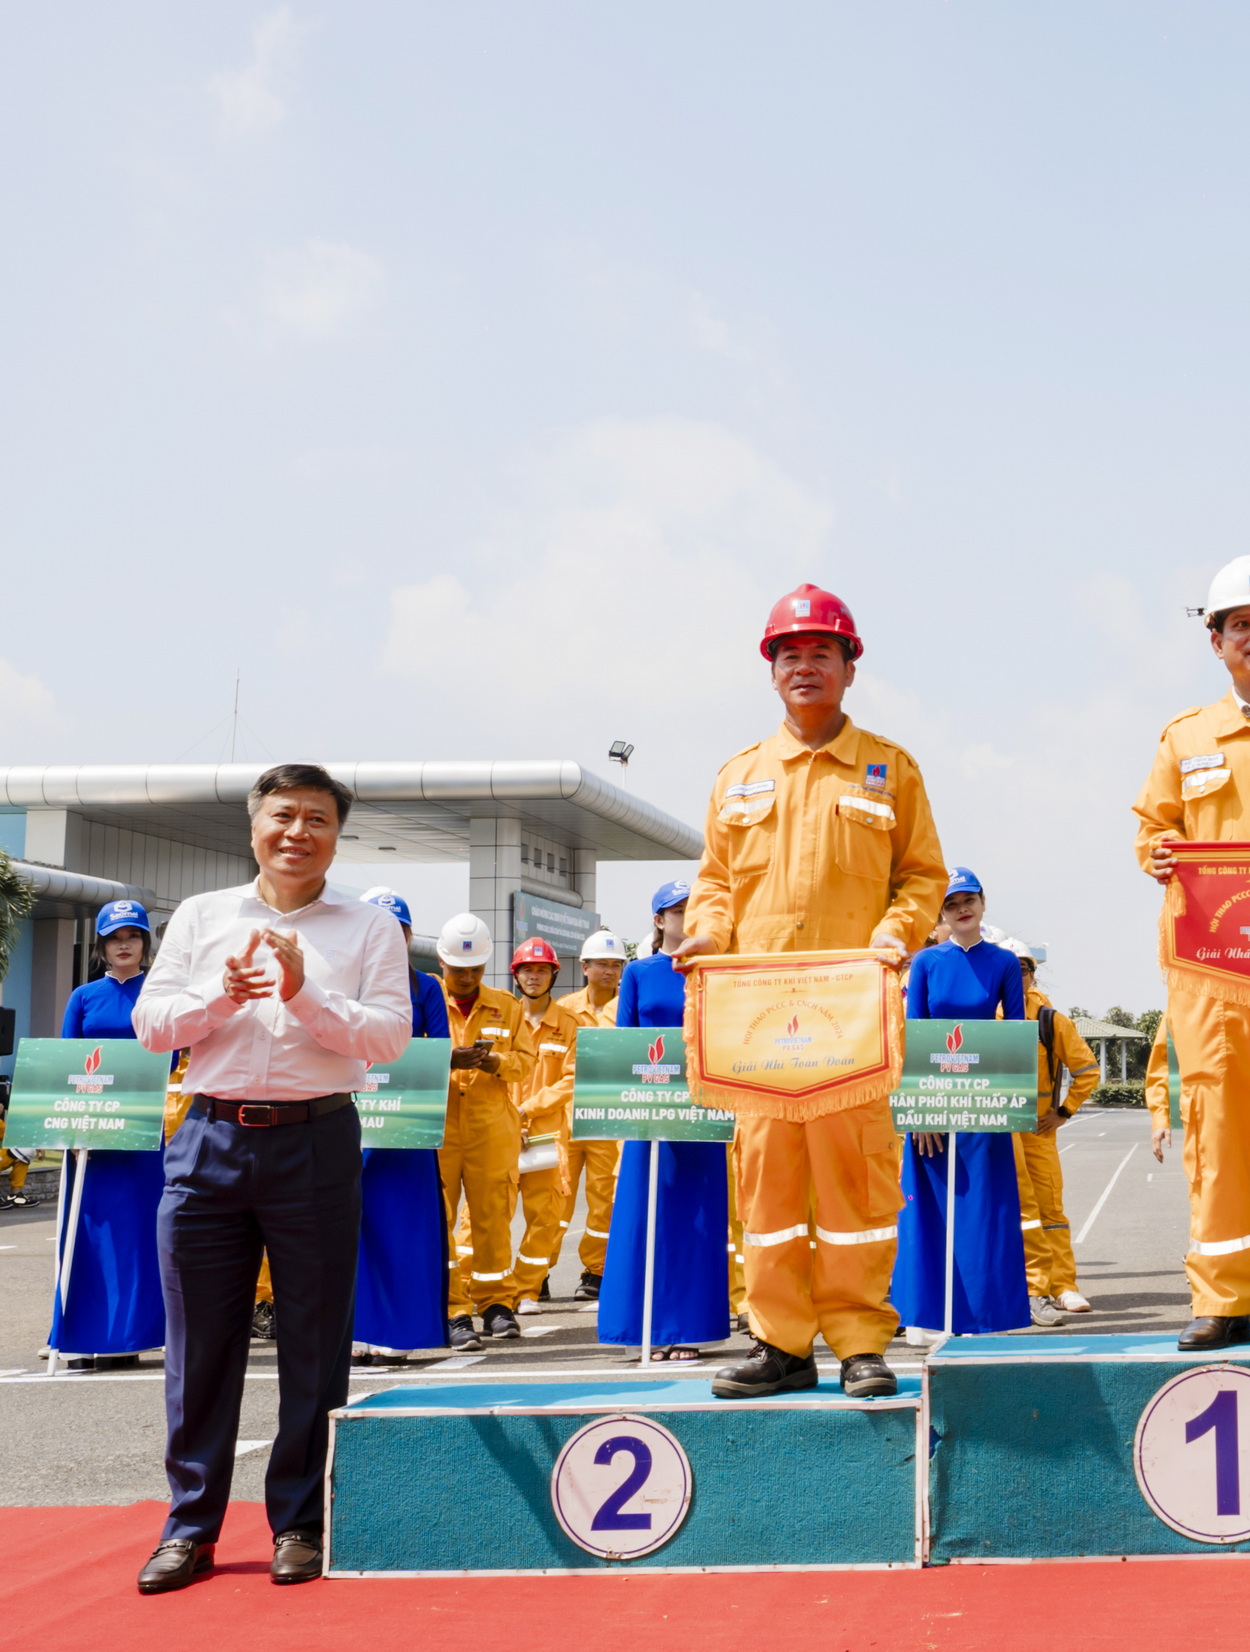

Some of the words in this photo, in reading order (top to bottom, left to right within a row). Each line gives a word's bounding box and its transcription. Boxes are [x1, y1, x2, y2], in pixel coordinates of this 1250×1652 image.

[1218, 866, 1237, 875] CÔNG
[1215, 900, 1232, 918] THAO
[1196, 947, 1221, 960] Giải
[753, 979, 772, 987] CÔNG
[774, 978, 781, 986] TY
[814, 975, 830, 983] NAM
[835, 973, 854, 981] CTCP
[749, 1011, 767, 1031] THAO
[766, 1000, 786, 1015] PCCC
[796, 999, 818, 1011] CNCH
[831, 1021, 843, 1039] 2024
[919, 1075, 953, 1089] CÔNG
[955, 1079, 971, 1089] TY
[973, 1079, 990, 1089] CP
[621, 1088, 654, 1102] CÔNG
[656, 1091, 671, 1102] TY
[674, 1091, 690, 1102] CP
[889, 1093, 915, 1107] HÂN
[918, 1092, 948, 1107] PHỐI
[950, 1093, 972, 1107] KHÍ
[974, 1092, 1008, 1108] THẤP
[1009, 1093, 1027, 1108] ÁP
[54, 1098, 86, 1112] CÔNG
[88, 1101, 103, 1112] TY
[105, 1101, 120, 1112] CP
[360, 1100, 376, 1111] TY
[379, 1096, 402, 1111] KHÍ
[575, 1108, 605, 1120] KINH
[607, 1108, 649, 1120] DOANH
[652, 1108, 676, 1120] LPG
[677, 1105, 705, 1123] VIỆT
[707, 1109, 735, 1120] NAM
[897, 1109, 922, 1125] DẦU
[925, 1111, 947, 1125] KHÍ
[949, 1111, 977, 1128] VIỆT
[979, 1114, 1007, 1126] NAM
[44, 1117, 68, 1129] CNG
[71, 1115, 97, 1132] VIỆT
[98, 1118, 125, 1130] NAM
[1185, 1390, 1240, 1516] 1
[590, 1435, 653, 1531] 2
